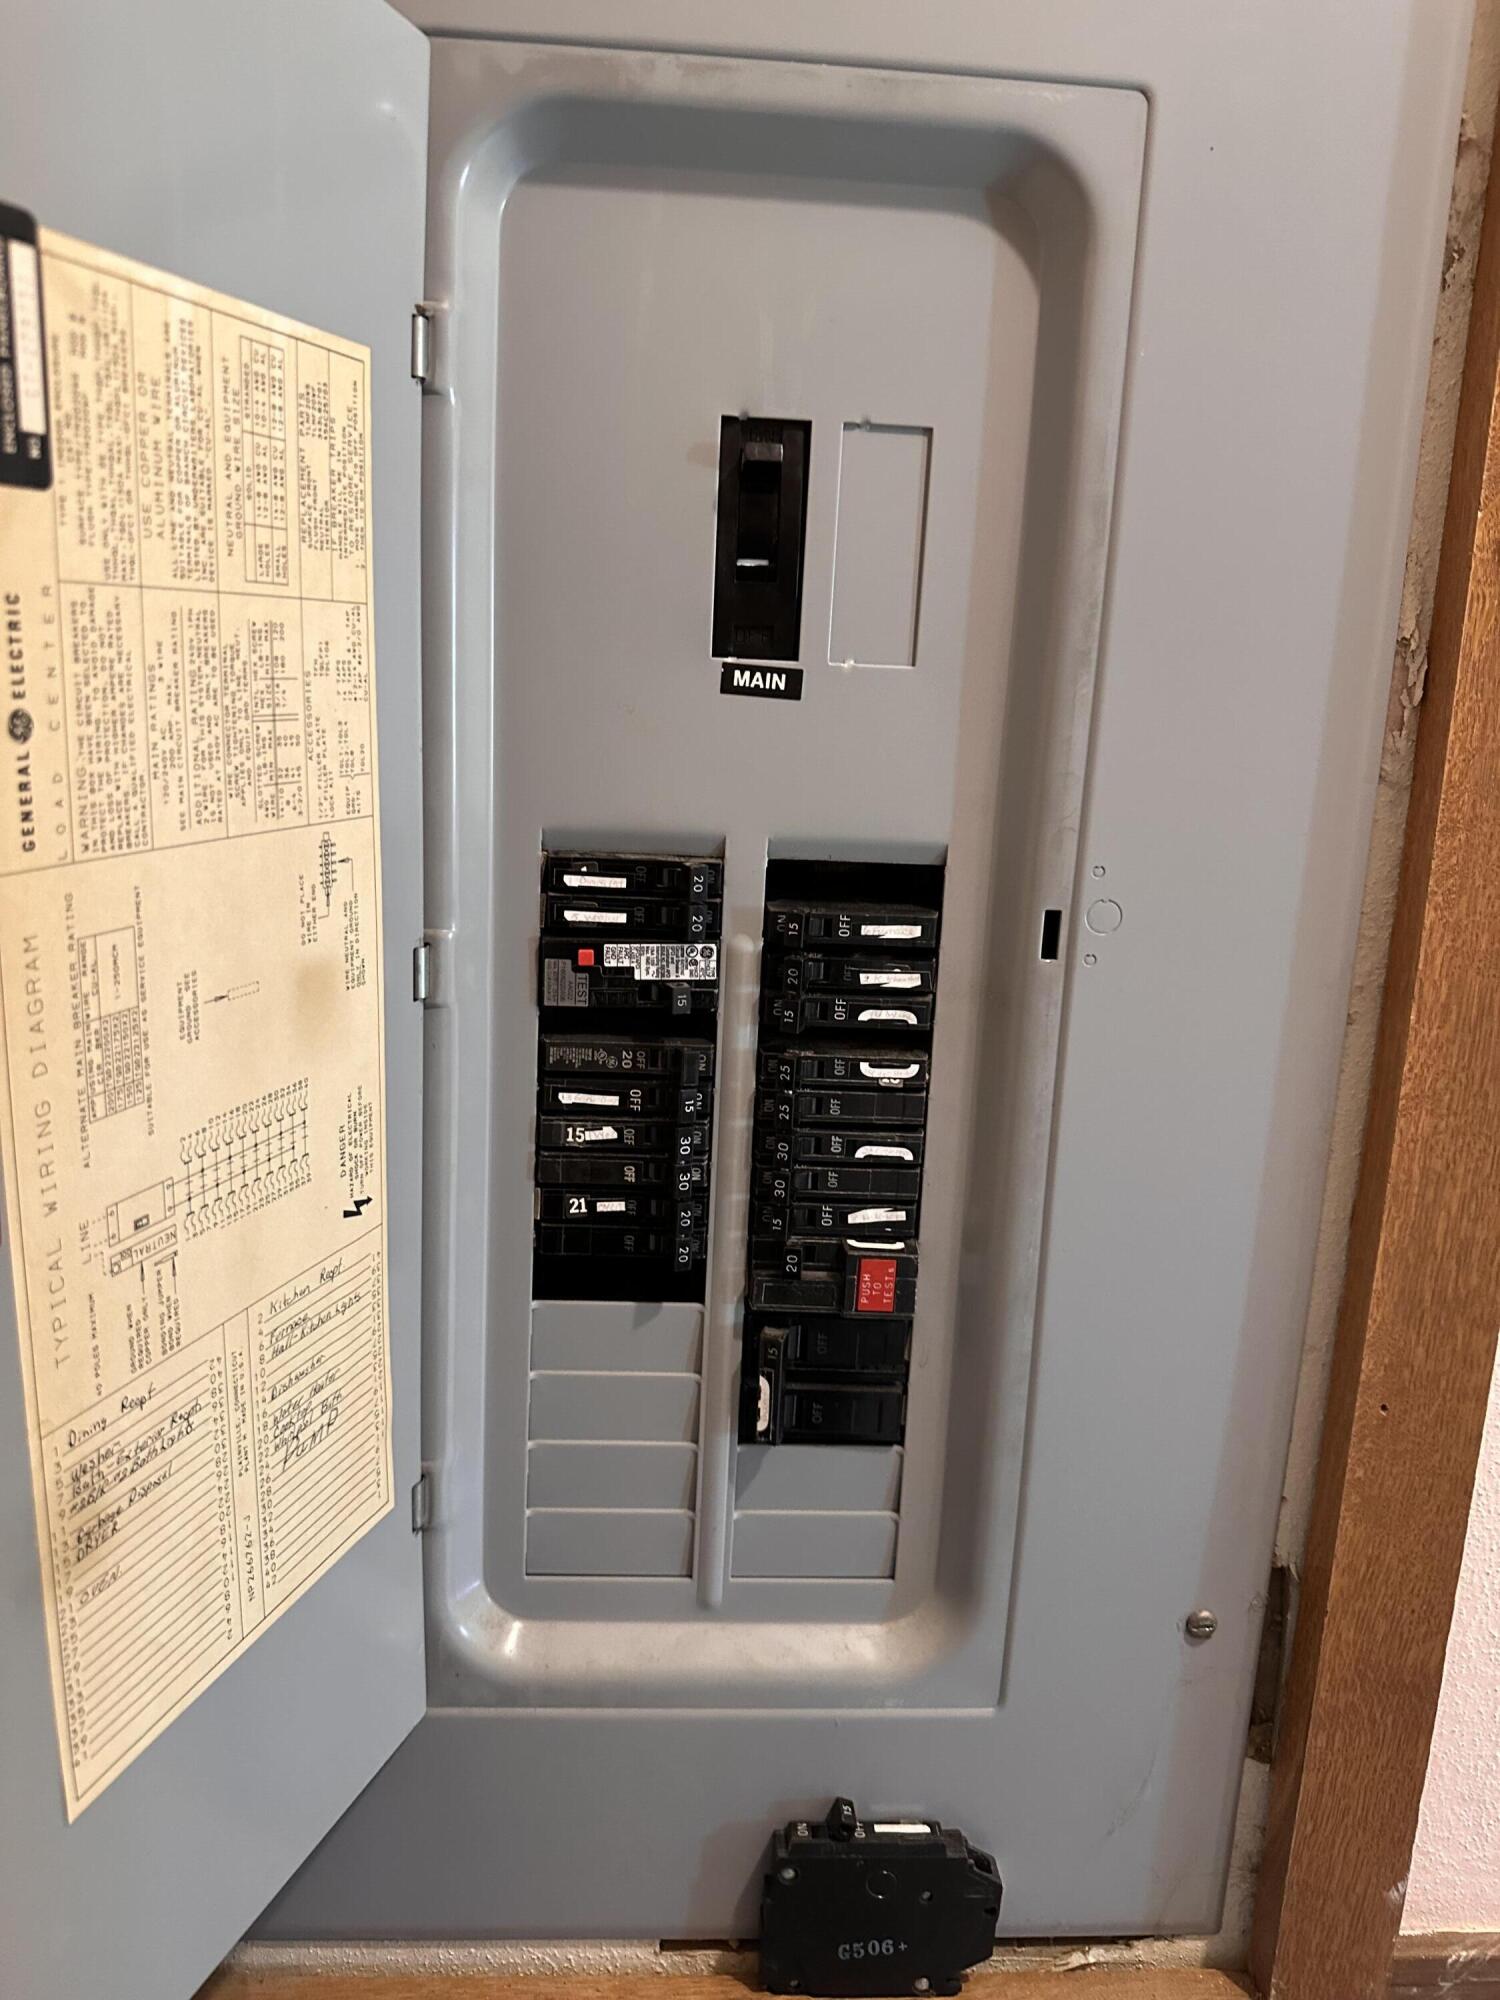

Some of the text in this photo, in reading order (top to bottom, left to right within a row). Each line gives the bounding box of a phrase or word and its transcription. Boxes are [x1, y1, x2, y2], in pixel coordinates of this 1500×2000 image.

[219, 353, 232, 444] EQUIPMENT
[136, 370, 153, 539] USE COPPER OR
[149, 374, 166, 540] ALUMINUM WIRE
[732, 669, 788, 692] MAIN
[3, 590, 37, 853] GENERAL ELECTRIC
[38, 583, 69, 861] LOAD CENTER
[146, 663, 160, 780] MAIN RATINGS
[693, 875, 704, 893] 20
[691, 915, 703, 933] 20
[788, 922, 799, 936] 15
[838, 913, 852, 938] OFF
[787, 968, 799, 985] 20
[577, 975, 588, 1006] TEST
[676, 993, 688, 1008] 15
[834, 997, 848, 1021] OFF
[783, 1010, 795, 1023] 15
[63, 891, 91, 1170] ALTERNATE MAIN BREAKER RATING
[621, 1049, 634, 1069] 20
[636, 1050, 646, 1070] OFF
[698, 1054, 707, 1071] ON
[833, 1058, 846, 1076] OFF
[779, 1064, 791, 1081] 25
[629, 1088, 642, 1113] OFF
[684, 1099, 695, 1113] 15
[829, 1097, 841, 1116] OFF
[779, 1104, 790, 1121] 25
[565, 1127, 586, 1143] 15
[623, 1128, 635, 1146] OFF
[830, 1135, 843, 1154] OFF
[20, 932, 71, 1370] TYPICAL WIRING DIAGRAM
[679, 1136, 691, 1156] 30
[776, 1142, 789, 1161] 30
[623, 1165, 636, 1183] OFF
[678, 1172, 691, 1191] 30
[827, 1170, 840, 1189] OFF
[773, 1179, 786, 1199] 30
[568, 1197, 589, 1214] 21
[680, 1210, 692, 1228] 20
[772, 1218, 783, 1231] 15
[821, 1204, 833, 1227] OFF
[78, 1218, 92, 1266] LINE
[132, 1227, 176, 1261] NEUTRAL
[678, 1246, 690, 1263] 20
[785, 1254, 799, 1273] 20
[861, 1273, 871, 1305] PUSH
[872, 1282, 882, 1296] TO
[883, 1274, 895, 1304] TEST
[269, 1285, 310, 1315] Kitchen
[87, 1290, 98, 1341] MAXIMUM
[767, 1346, 778, 1360] 15
[811, 1401, 824, 1425] OFF
[68, 1418, 107, 1448] Dining
[242, 1510, 255, 1605] NP266762-J
[842, 1804, 853, 1816] 15
